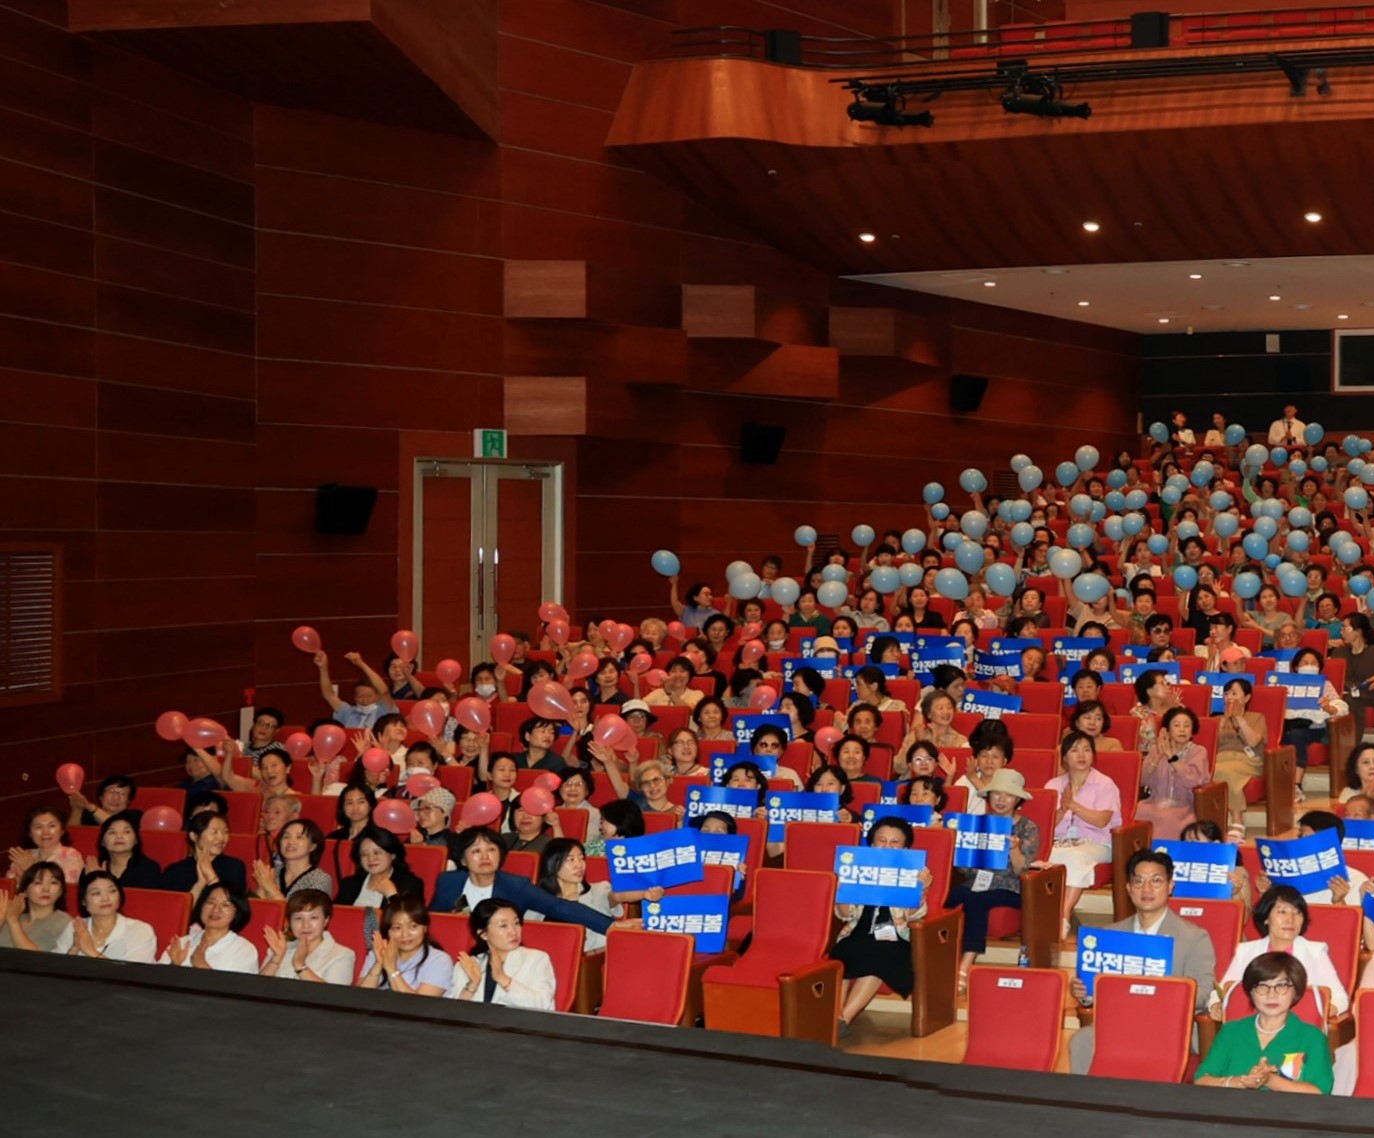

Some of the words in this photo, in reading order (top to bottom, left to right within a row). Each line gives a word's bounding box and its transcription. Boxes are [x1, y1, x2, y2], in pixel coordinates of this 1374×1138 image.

[612, 845, 697, 874] 안전돌봄
[1263, 847, 1340, 877] 안전돌봄
[838, 864, 919, 888] 안전돌봄
[1173, 861, 1228, 884] 전돌봄
[647, 914, 723, 933] 안전돌봄
[1081, 950, 1167, 977] 안전돌봄
